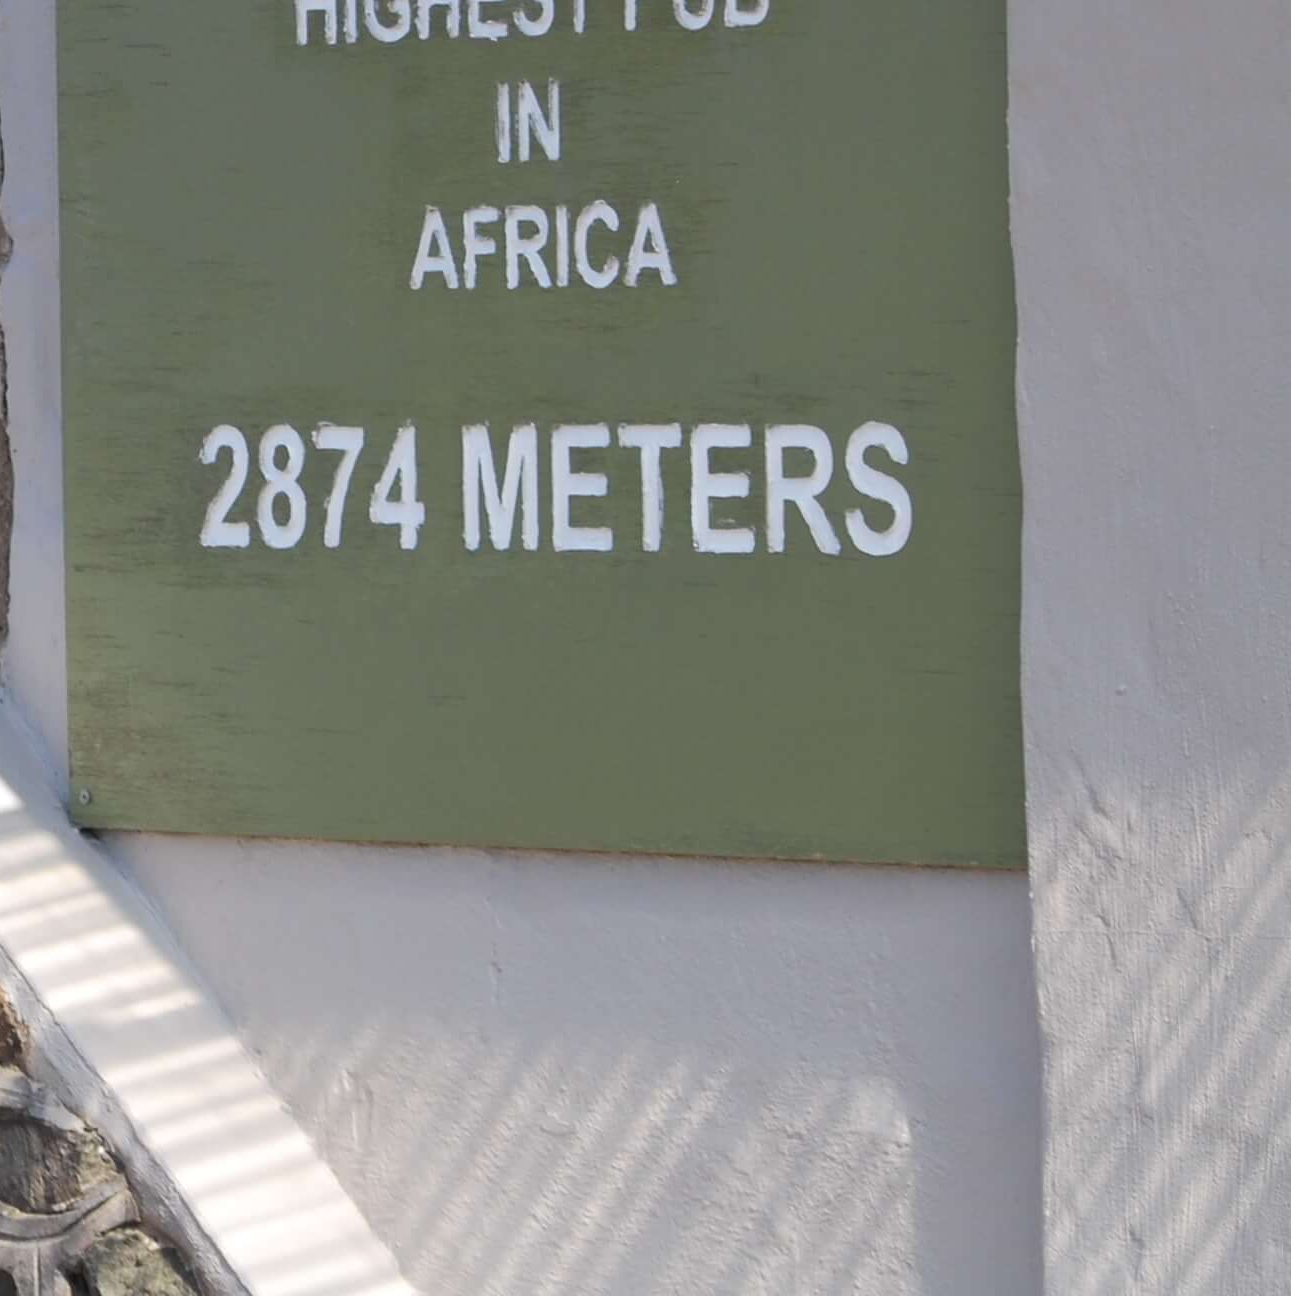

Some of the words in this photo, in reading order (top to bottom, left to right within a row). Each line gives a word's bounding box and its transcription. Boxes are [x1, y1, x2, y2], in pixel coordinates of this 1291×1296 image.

[496, 77, 562, 164] IN
[409, 199, 678, 291] AFRICA
[198, 421, 426, 551] 2874
[462, 420, 913, 557] METERS
